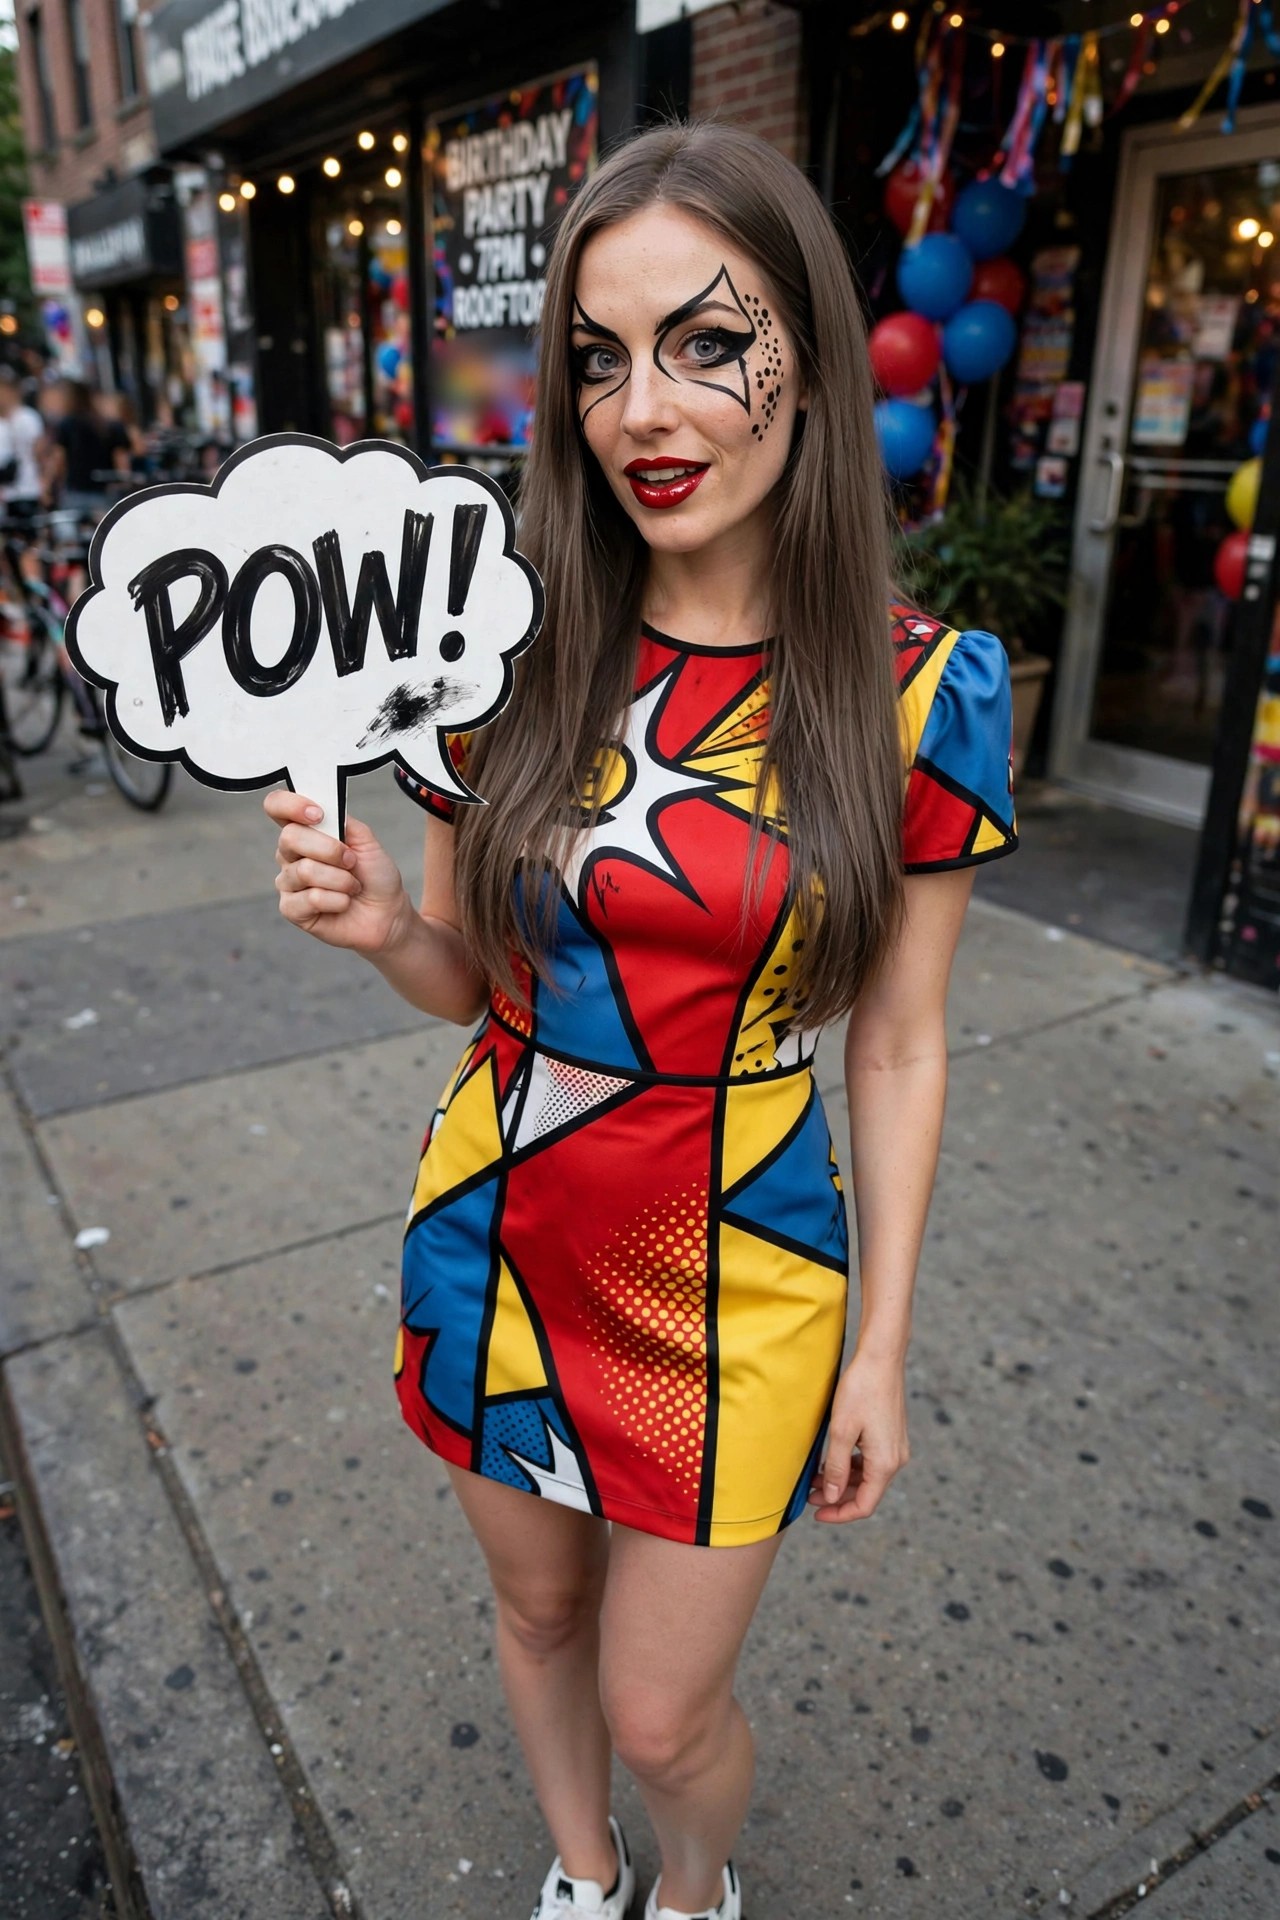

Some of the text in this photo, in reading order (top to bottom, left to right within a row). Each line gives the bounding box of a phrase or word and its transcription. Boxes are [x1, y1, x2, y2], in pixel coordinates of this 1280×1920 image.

[445, 108, 572, 192] BIRTHDAY
[463, 173, 550, 238] PARTY
[474, 232, 526, 282] 7PM
[128, 503, 488, 728] POW!
